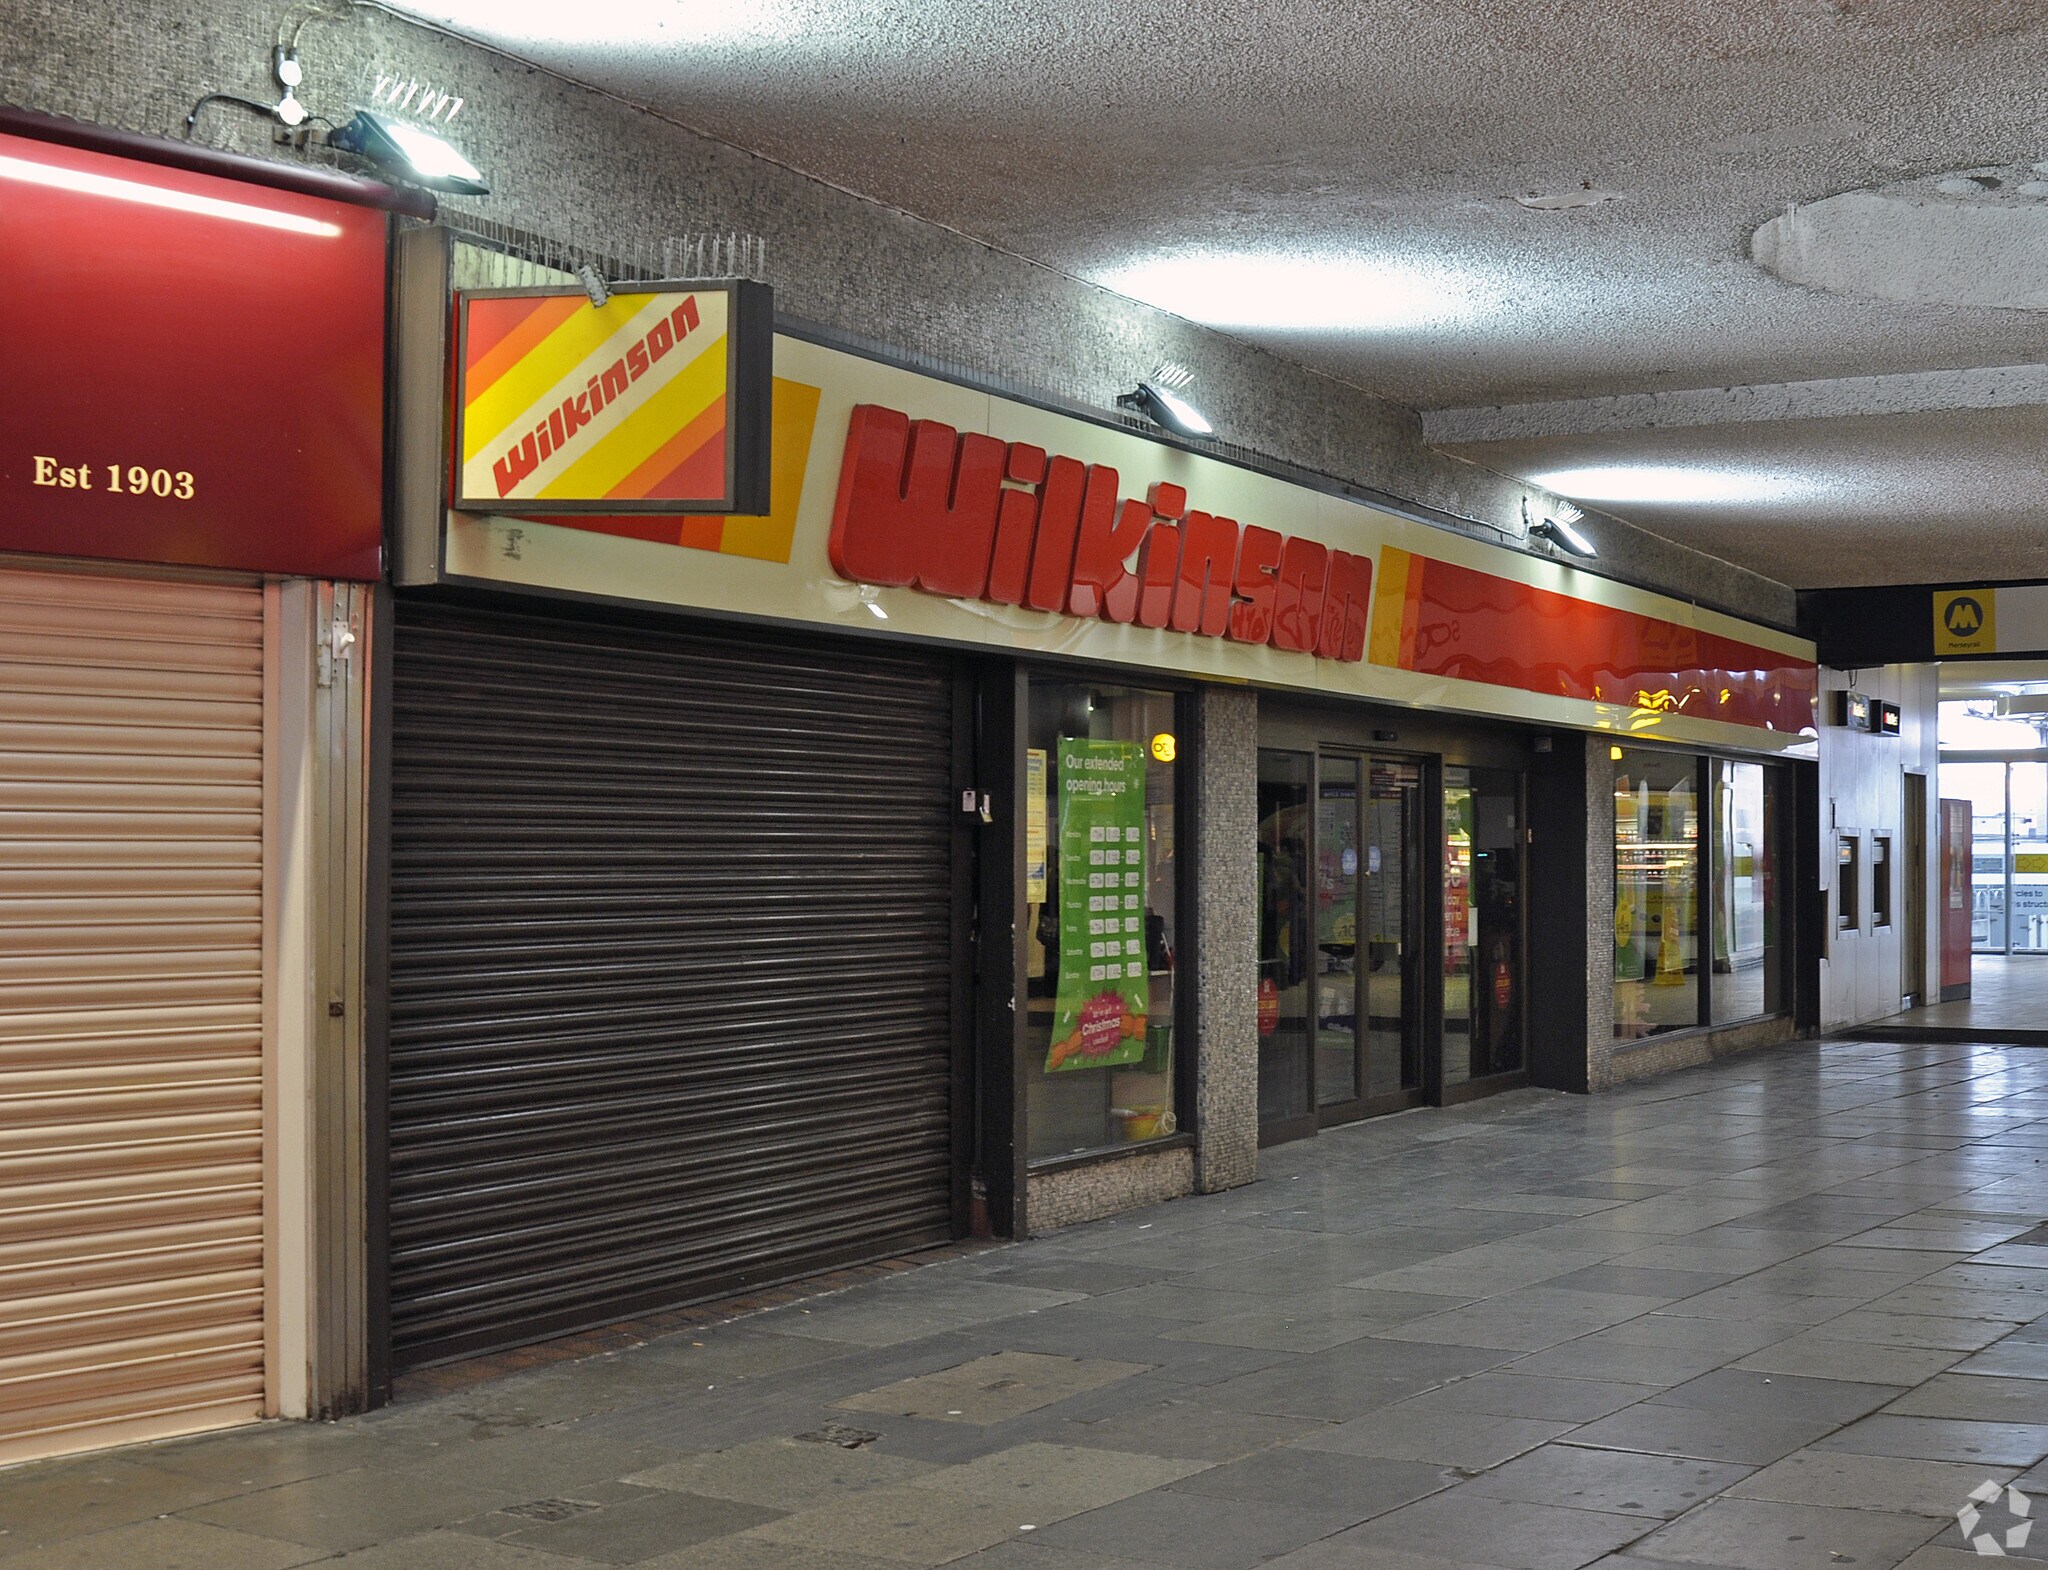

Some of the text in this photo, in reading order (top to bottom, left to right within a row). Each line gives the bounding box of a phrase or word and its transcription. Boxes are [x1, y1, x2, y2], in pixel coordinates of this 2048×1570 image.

[33, 455, 195, 500] Est 1903
[1066, 754, 1125, 771] Our extended
[1066, 777, 1127, 795] opening hours
[1082, 1017, 1121, 1036] Christmas
